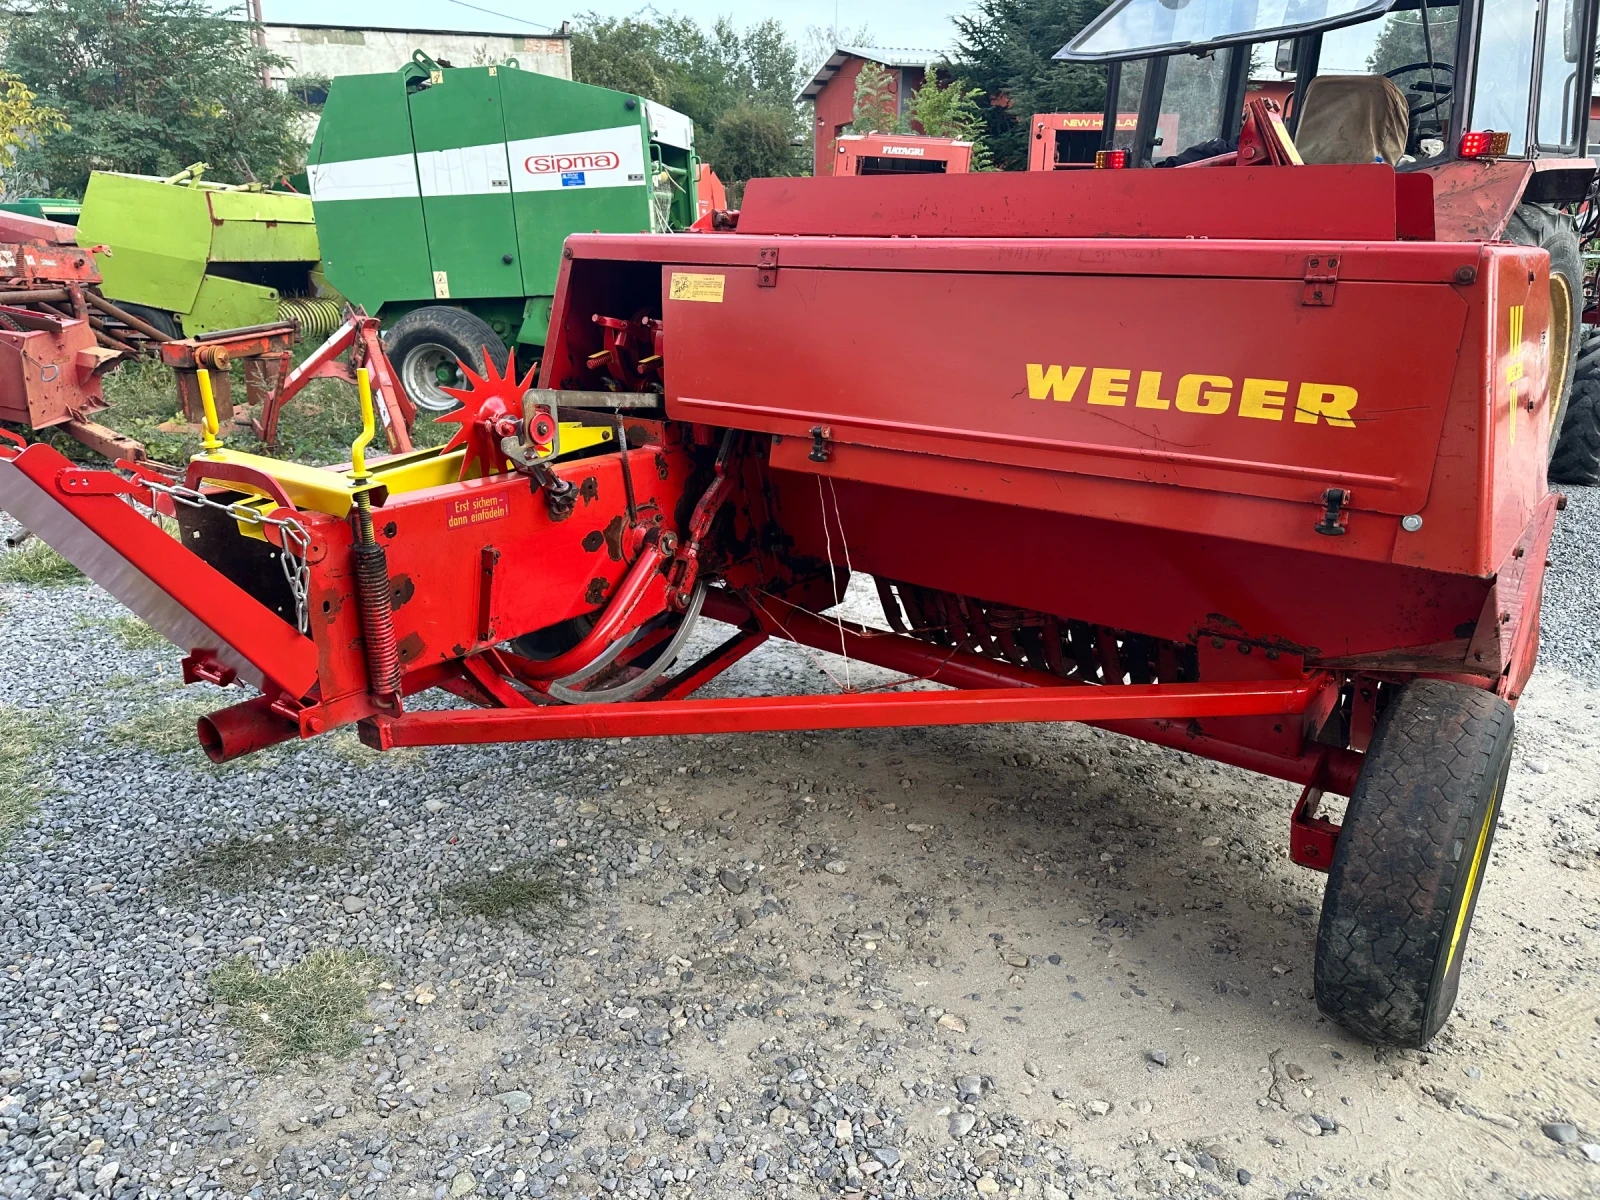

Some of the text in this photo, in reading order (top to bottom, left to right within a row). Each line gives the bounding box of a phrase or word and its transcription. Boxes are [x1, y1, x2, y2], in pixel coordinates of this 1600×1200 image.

[1063, 119, 1138, 127] NEW HLAN
[882, 146, 925, 156] FIATAGRI
[1026, 363, 1359, 428] WELGER
[455, 499, 469, 513] Erst
[448, 515, 468, 527] dann
